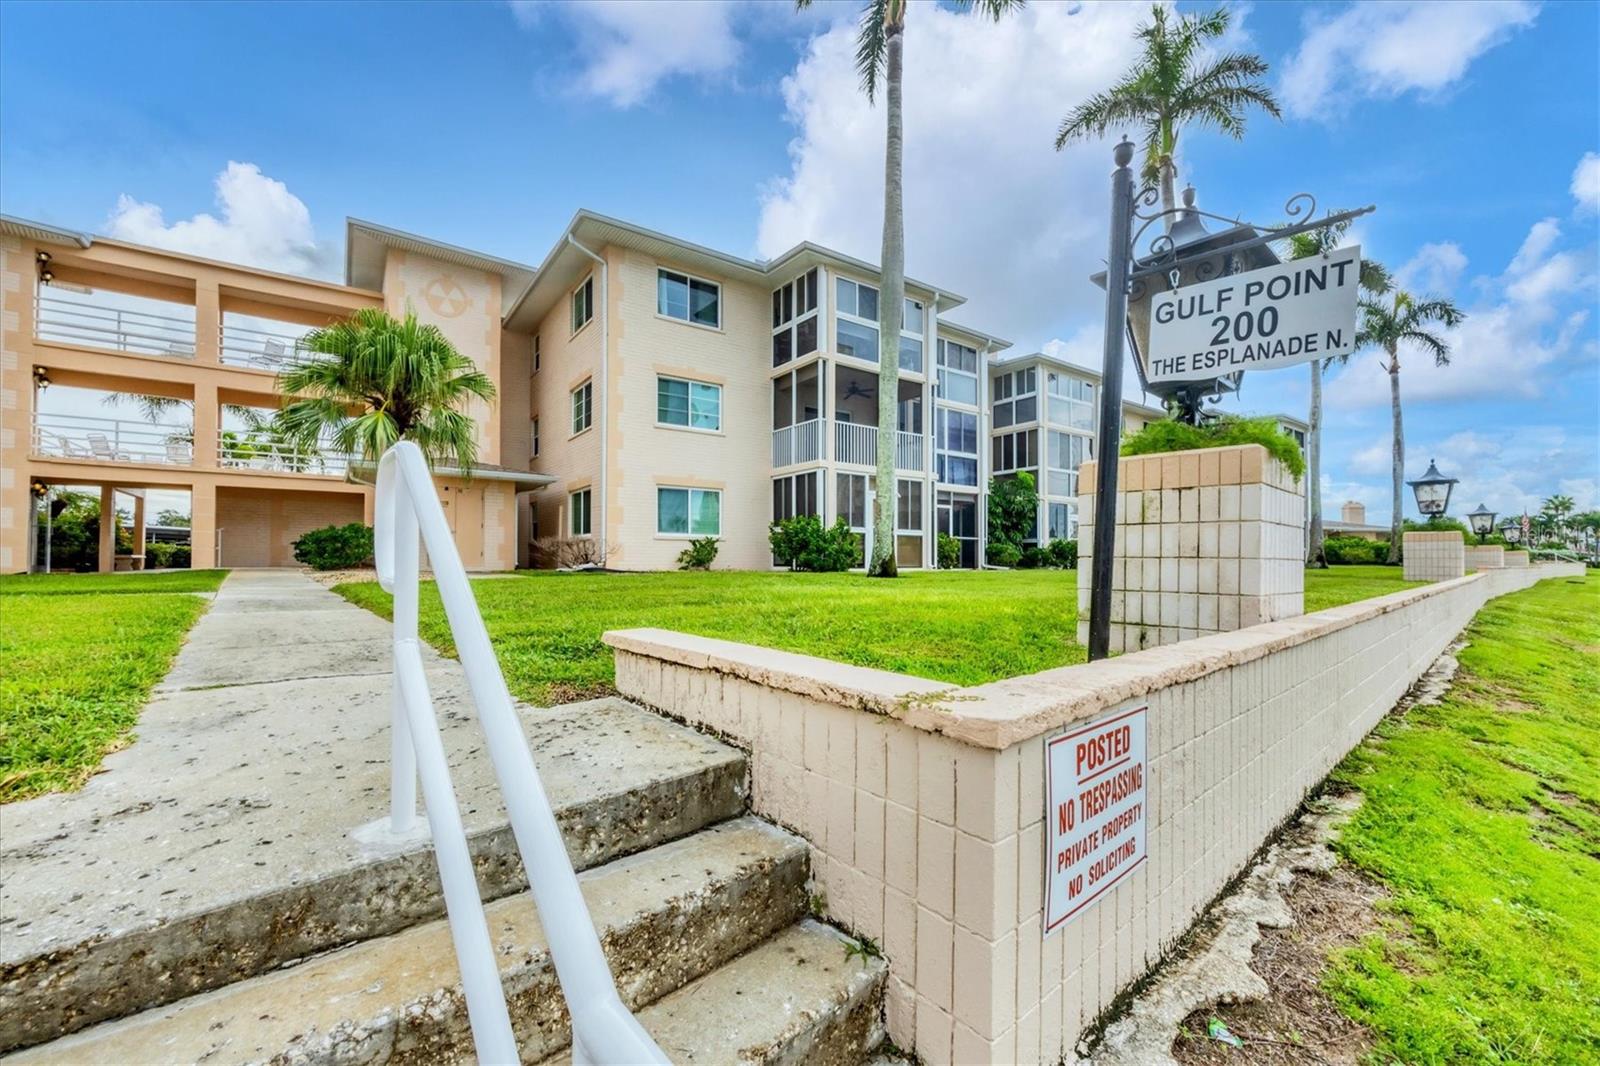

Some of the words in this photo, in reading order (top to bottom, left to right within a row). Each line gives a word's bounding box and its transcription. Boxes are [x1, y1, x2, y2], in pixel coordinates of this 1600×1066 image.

[1155, 287, 1234, 324] GULF
[1245, 260, 1353, 306] POINT
[1152, 355, 1186, 376] THE
[1192, 334, 1318, 369] ESPLANADE
[1326, 329, 1348, 350] N.
[1209, 306, 1279, 346] 200
[1076, 725, 1130, 776] POSTED
[1058, 798, 1075, 836] NO
[1079, 763, 1142, 823] TRESPASSING
[1058, 829, 1099, 874] PRIVATE
[1102, 802, 1143, 844] PROPERTY
[1068, 874, 1083, 900] NO
[1088, 836, 1136, 886] SOLICITING
